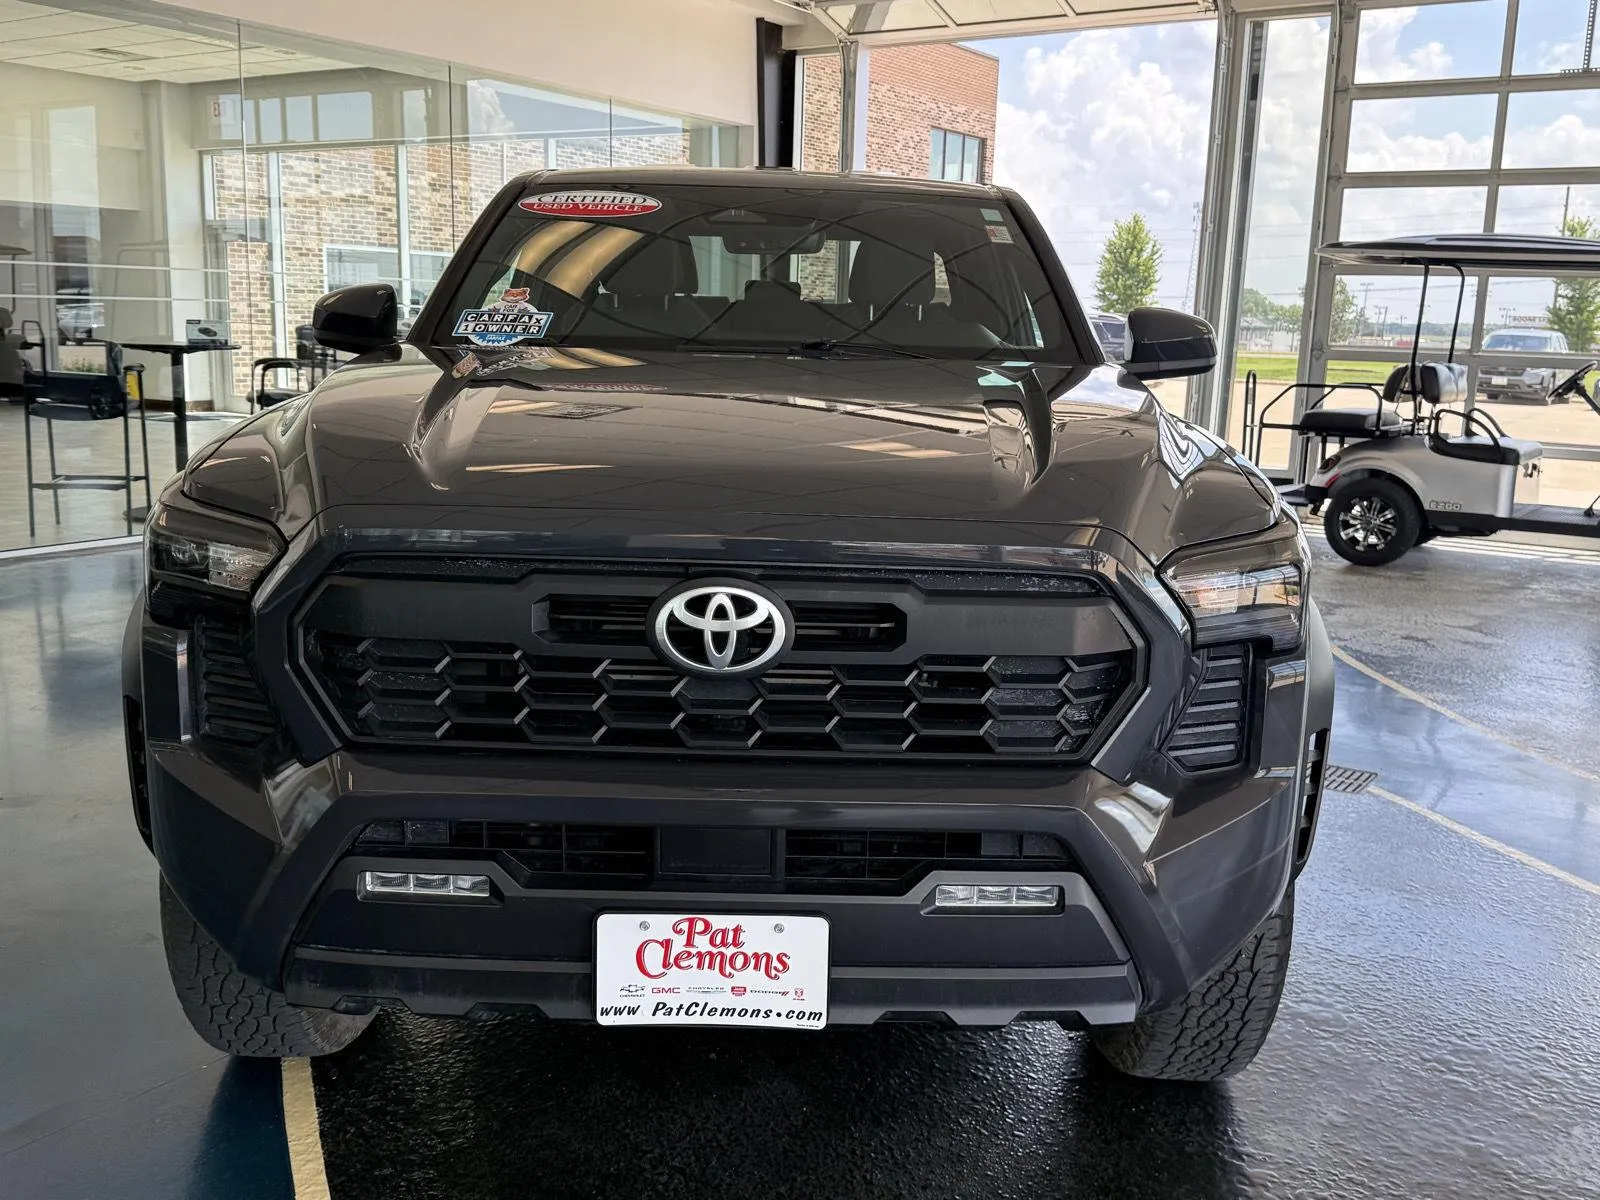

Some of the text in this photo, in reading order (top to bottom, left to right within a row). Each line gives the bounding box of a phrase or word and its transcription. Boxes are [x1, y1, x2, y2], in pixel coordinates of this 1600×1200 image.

[537, 194, 647, 204] CERTIFIED
[578, 203, 642, 212] VEHICLE
[466, 313, 543, 325] CARFAX
[463, 324, 540, 334] 1 OWNER
[672, 916, 746, 949] Pat
[635, 937, 791, 981] Clemons
